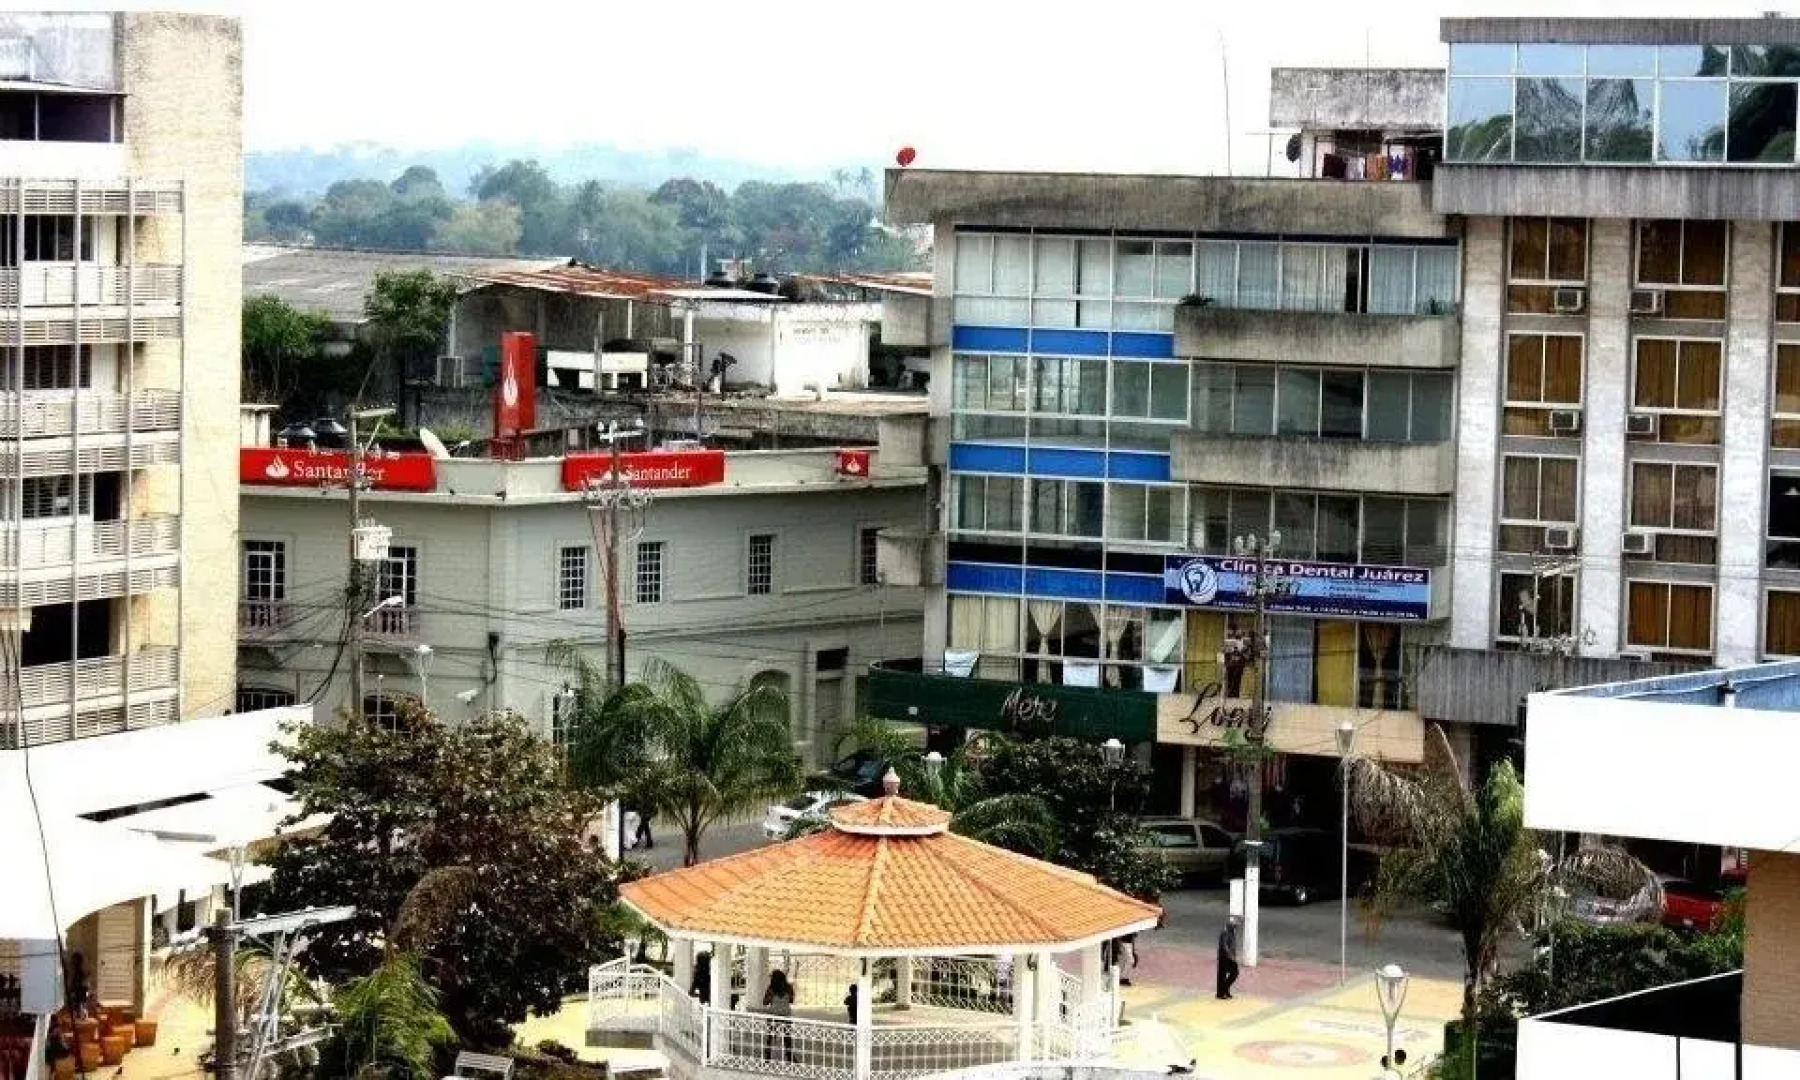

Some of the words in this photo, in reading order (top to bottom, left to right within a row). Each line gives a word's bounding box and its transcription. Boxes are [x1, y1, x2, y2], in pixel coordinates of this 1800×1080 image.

[625, 461, 692, 481] Santander
[1289, 563, 1355, 579] Dental
[1358, 567, 1425, 582] Juárez
